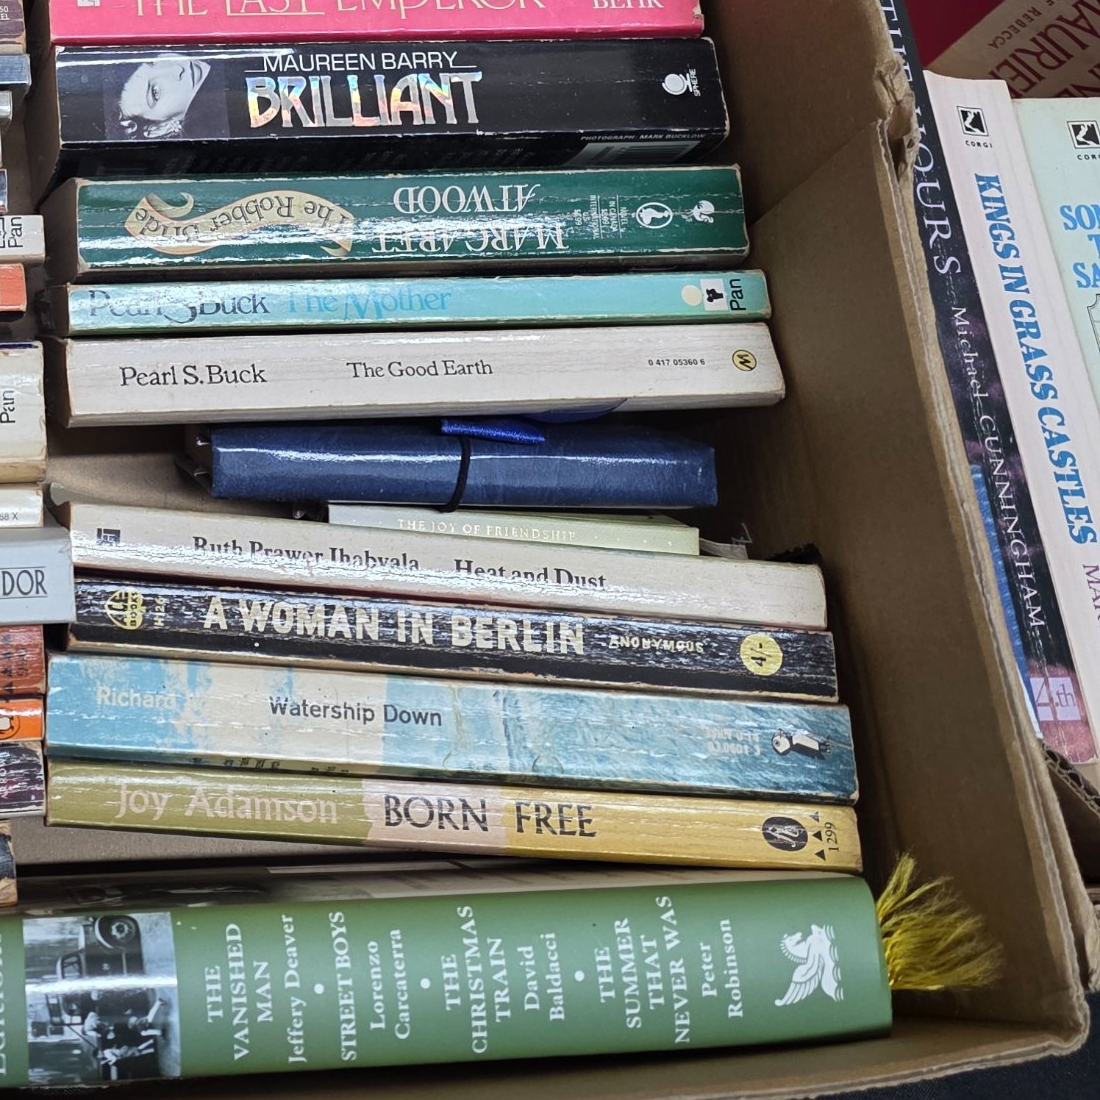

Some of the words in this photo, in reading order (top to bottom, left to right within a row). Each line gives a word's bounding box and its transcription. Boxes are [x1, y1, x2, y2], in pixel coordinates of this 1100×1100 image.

[988, 6, 1041, 49] REBECCA
[692, 68, 701, 97] SPHERE
[965, 140, 993, 149] CORGI
[394, 184, 540, 215] ATWOOD
[975, 173, 1021, 259] KINGS
[998, 264, 1030, 294] IN
[648, 359, 653, 367] 0
[656, 359, 670, 367] 417
[673, 359, 696, 367] 05360
[700, 358, 705, 366] 6
[1009, 299, 1058, 400] GRASS
[119, 366, 179, 387] Pearl
[183, 366, 204, 385] S.
[207, 364, 267, 385] Buck
[347, 362, 385, 379] The
[389, 360, 437, 377] Good
[443, 358, 493, 376] Earth
[1037, 406, 1097, 545] CASTLES
[398, 518, 425, 530] THE
[431, 522, 456, 534] JOY
[463, 524, 480, 535] OF
[487, 526, 576, 542] FRIENDSHIP
[203, 597, 228, 630] A
[239, 599, 379, 641] WOMAN
[397, 610, 434, 645] IN
[451, 616, 584, 654] BERLIN
[608, 636, 704, 654] ANONYMOUS
[117, 784, 172, 820] Joy
[185, 786, 337, 824] Adamson
[383, 795, 488, 832] BORN
[515, 801, 597, 837] FREE
[226, 923, 250, 1060] VANISHED
